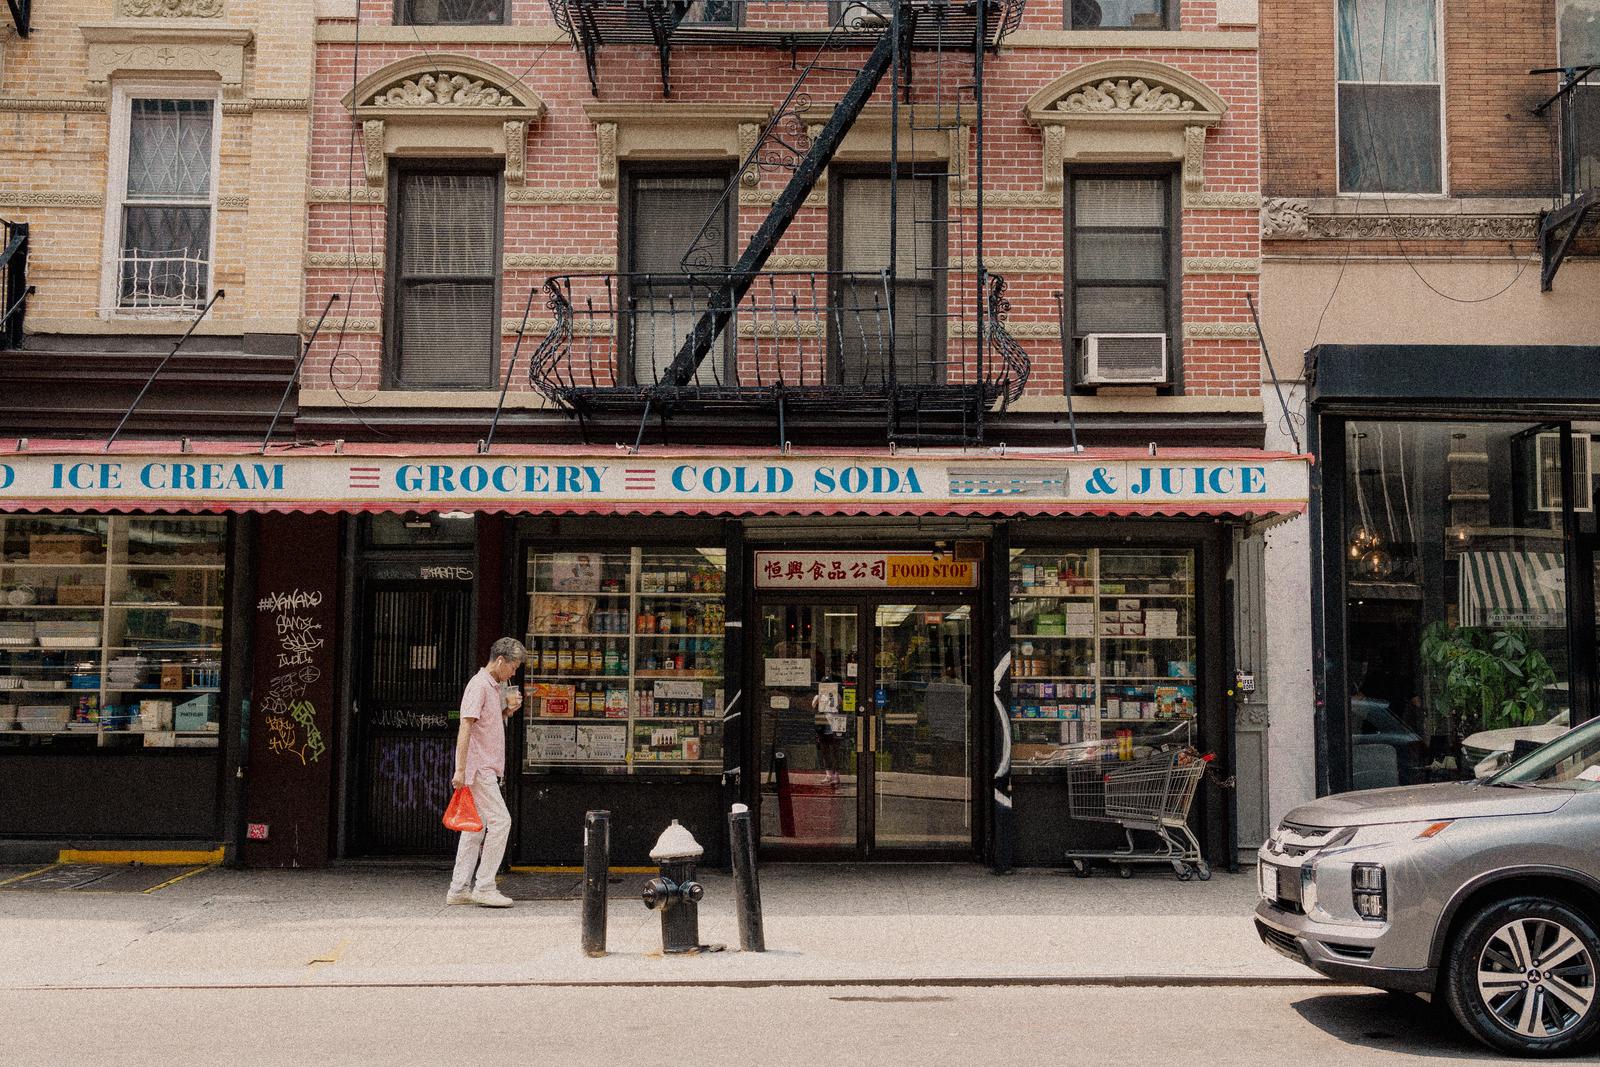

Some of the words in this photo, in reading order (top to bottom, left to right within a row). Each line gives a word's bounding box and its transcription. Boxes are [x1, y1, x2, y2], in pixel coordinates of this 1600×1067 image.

[52, 463, 122, 489] ICE
[140, 463, 286, 490] CREAM
[395, 464, 609, 493] GROCERY
[671, 465, 794, 493] COLD
[814, 466, 924, 493] SODA
[1085, 467, 1119, 495] &
[1131, 467, 1266, 494] JUICE
[891, 563, 930, 578] FOOD
[932, 563, 968, 578] STOP
